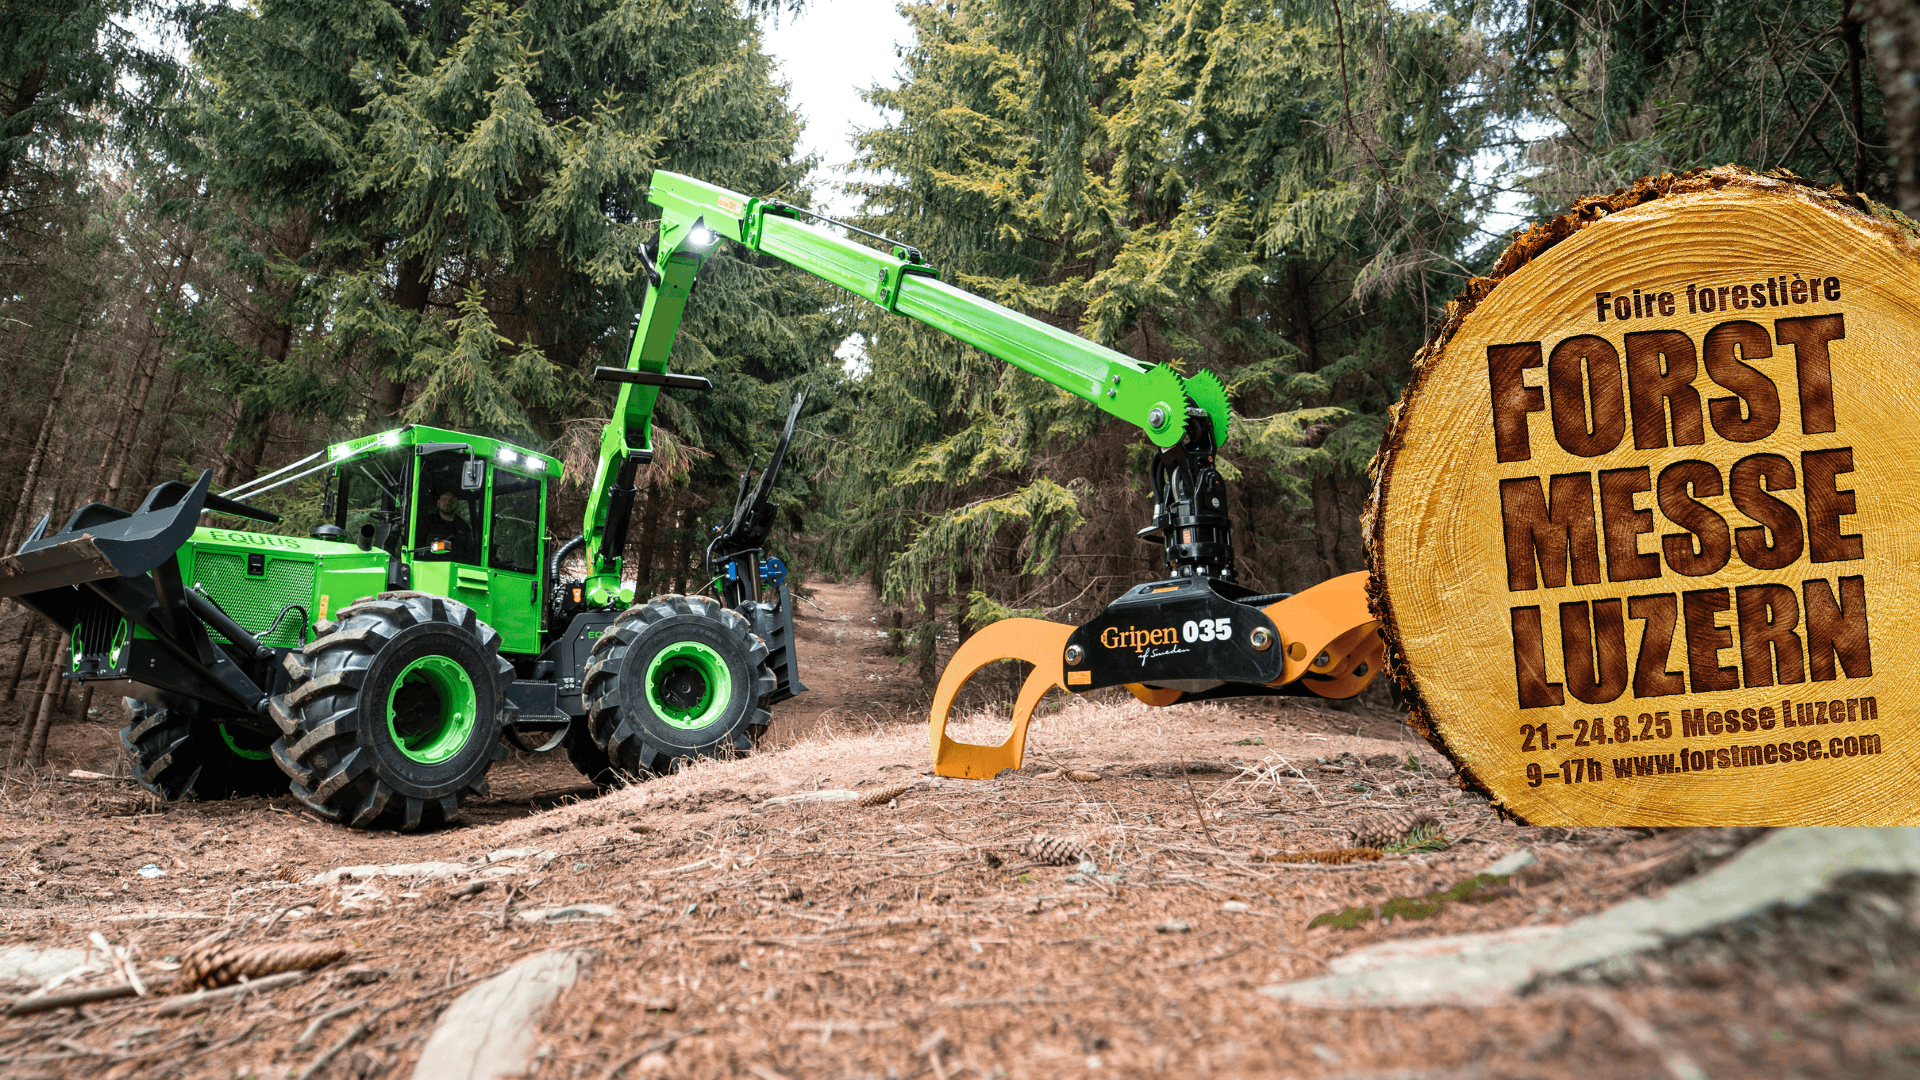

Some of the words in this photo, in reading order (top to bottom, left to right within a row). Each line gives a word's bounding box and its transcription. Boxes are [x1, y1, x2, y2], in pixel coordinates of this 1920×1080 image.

[210, 530, 301, 549] EQUUS
[587, 631, 603, 639] EQ
[1101, 625, 1180, 653] Gripen
[1182, 618, 1232, 643] 035
[1150, 644, 1191, 658] Sweden
